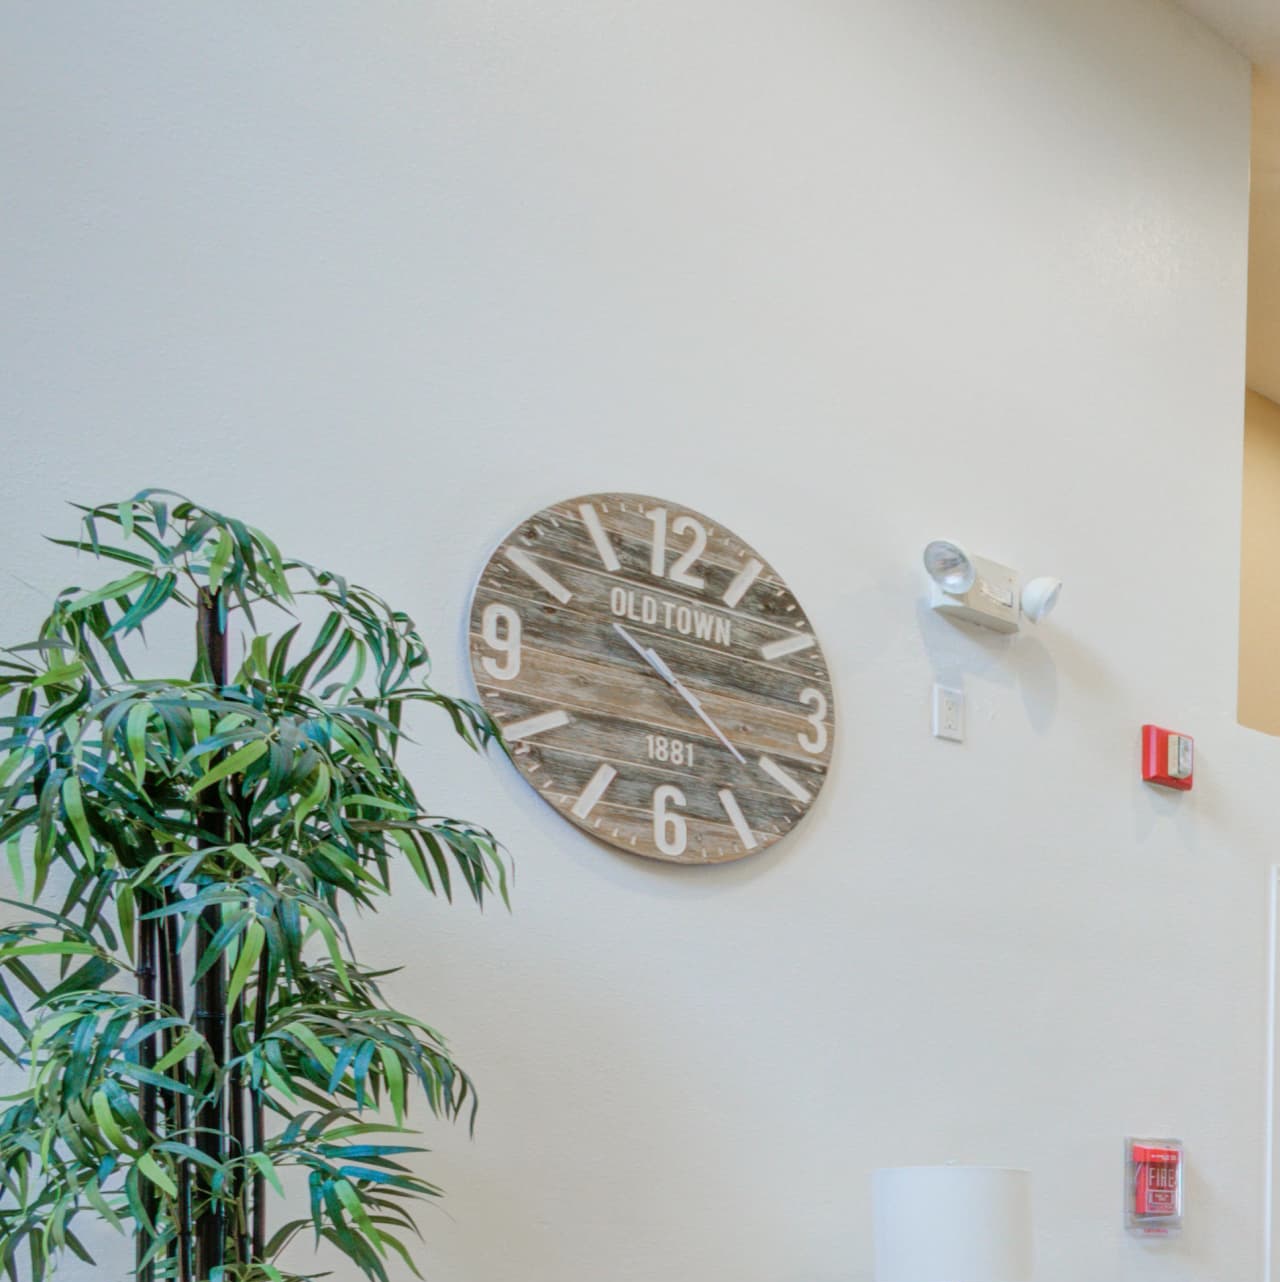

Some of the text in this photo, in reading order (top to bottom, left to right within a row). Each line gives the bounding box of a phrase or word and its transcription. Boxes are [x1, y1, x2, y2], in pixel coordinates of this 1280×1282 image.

[645, 507, 709, 590] 12
[481, 603, 522, 681] 9
[646, 735, 693, 767] 1881
[797, 687, 828, 754] 3
[653, 784, 688, 857] 6
[1148, 1167, 1175, 1188] FIRE
